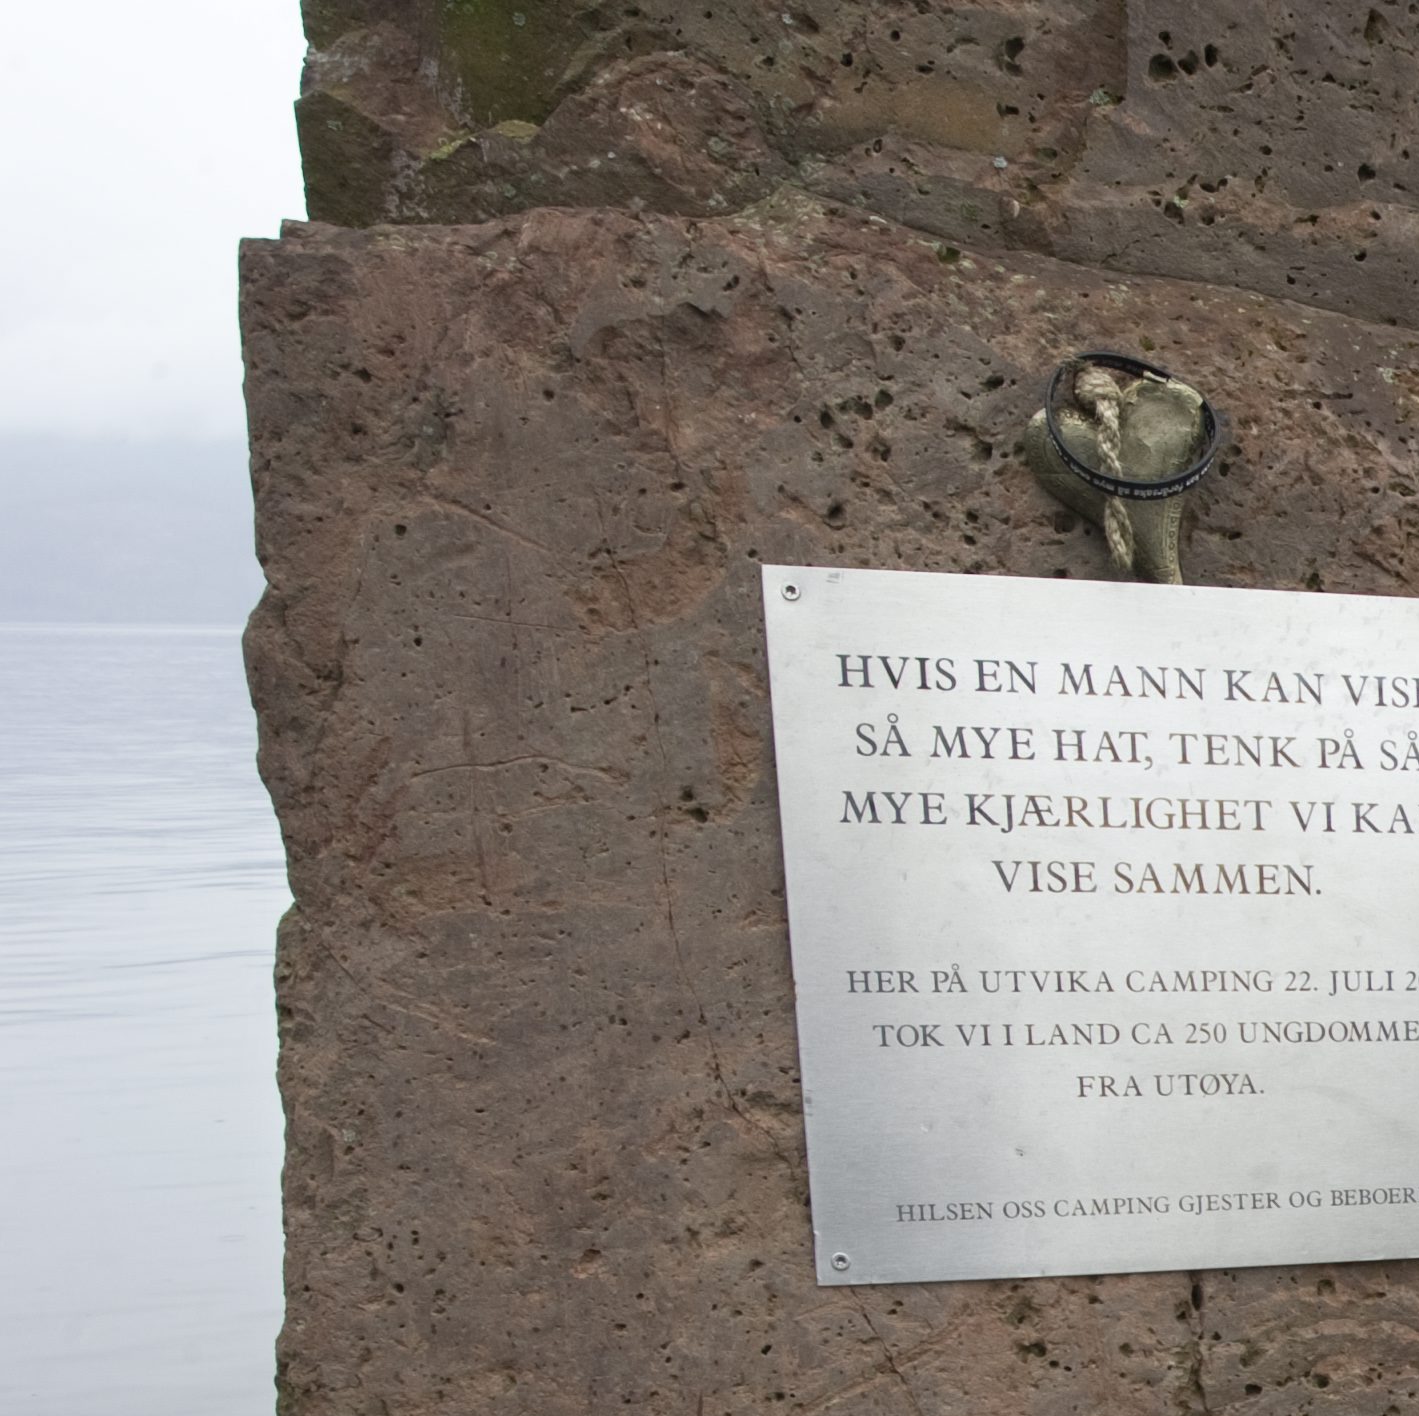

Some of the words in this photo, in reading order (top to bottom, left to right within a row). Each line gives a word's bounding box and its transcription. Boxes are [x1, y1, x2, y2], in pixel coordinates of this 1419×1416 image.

[835, 654, 957, 691] HVIS
[973, 659, 1038, 694] EN
[1058, 663, 1206, 700] MANN
[1223, 669, 1325, 705] KAN
[856, 713, 912, 757] SÅ
[930, 725, 1035, 760] MYE
[1052, 729, 1153, 770] HAT,
[1169, 733, 1301, 768] TENK
[1316, 728, 1365, 770] PÅ
[840, 791, 947, 825] MYE
[964, 794, 1272, 833] KJÆRLIGHET
[1289, 801, 1336, 832] VI
[991, 860, 1097, 893] VISE
[1114, 862, 1321, 896] SAMMEN.
[846, 971, 919, 993] HER
[930, 963, 968, 993] PÅ
[979, 971, 1114, 993] UTVIKA
[1126, 970, 1273, 992] CAMPING
[1285, 971, 1318, 991] 22.
[1328, 970, 1394, 996] JULI
[873, 1025, 944, 1047] TOK
[955, 1024, 992, 1046] VI
[1002, 1024, 1014, 1046] I
[1025, 1023, 1120, 1045] LAND
[1131, 1023, 1174, 1045] CA
[1185, 1023, 1227, 1044] 250
[1076, 1075, 1143, 1097] FRA
[1154, 1073, 1264, 1096] UTØYA.
[896, 1202, 993, 1222] HILSEN
[1003, 1200, 1046, 1219] OSS
[1054, 1196, 1169, 1217] CAMPING
[1179, 1193, 1281, 1215] GJESTER
[1289, 1191, 1322, 1208] OG
